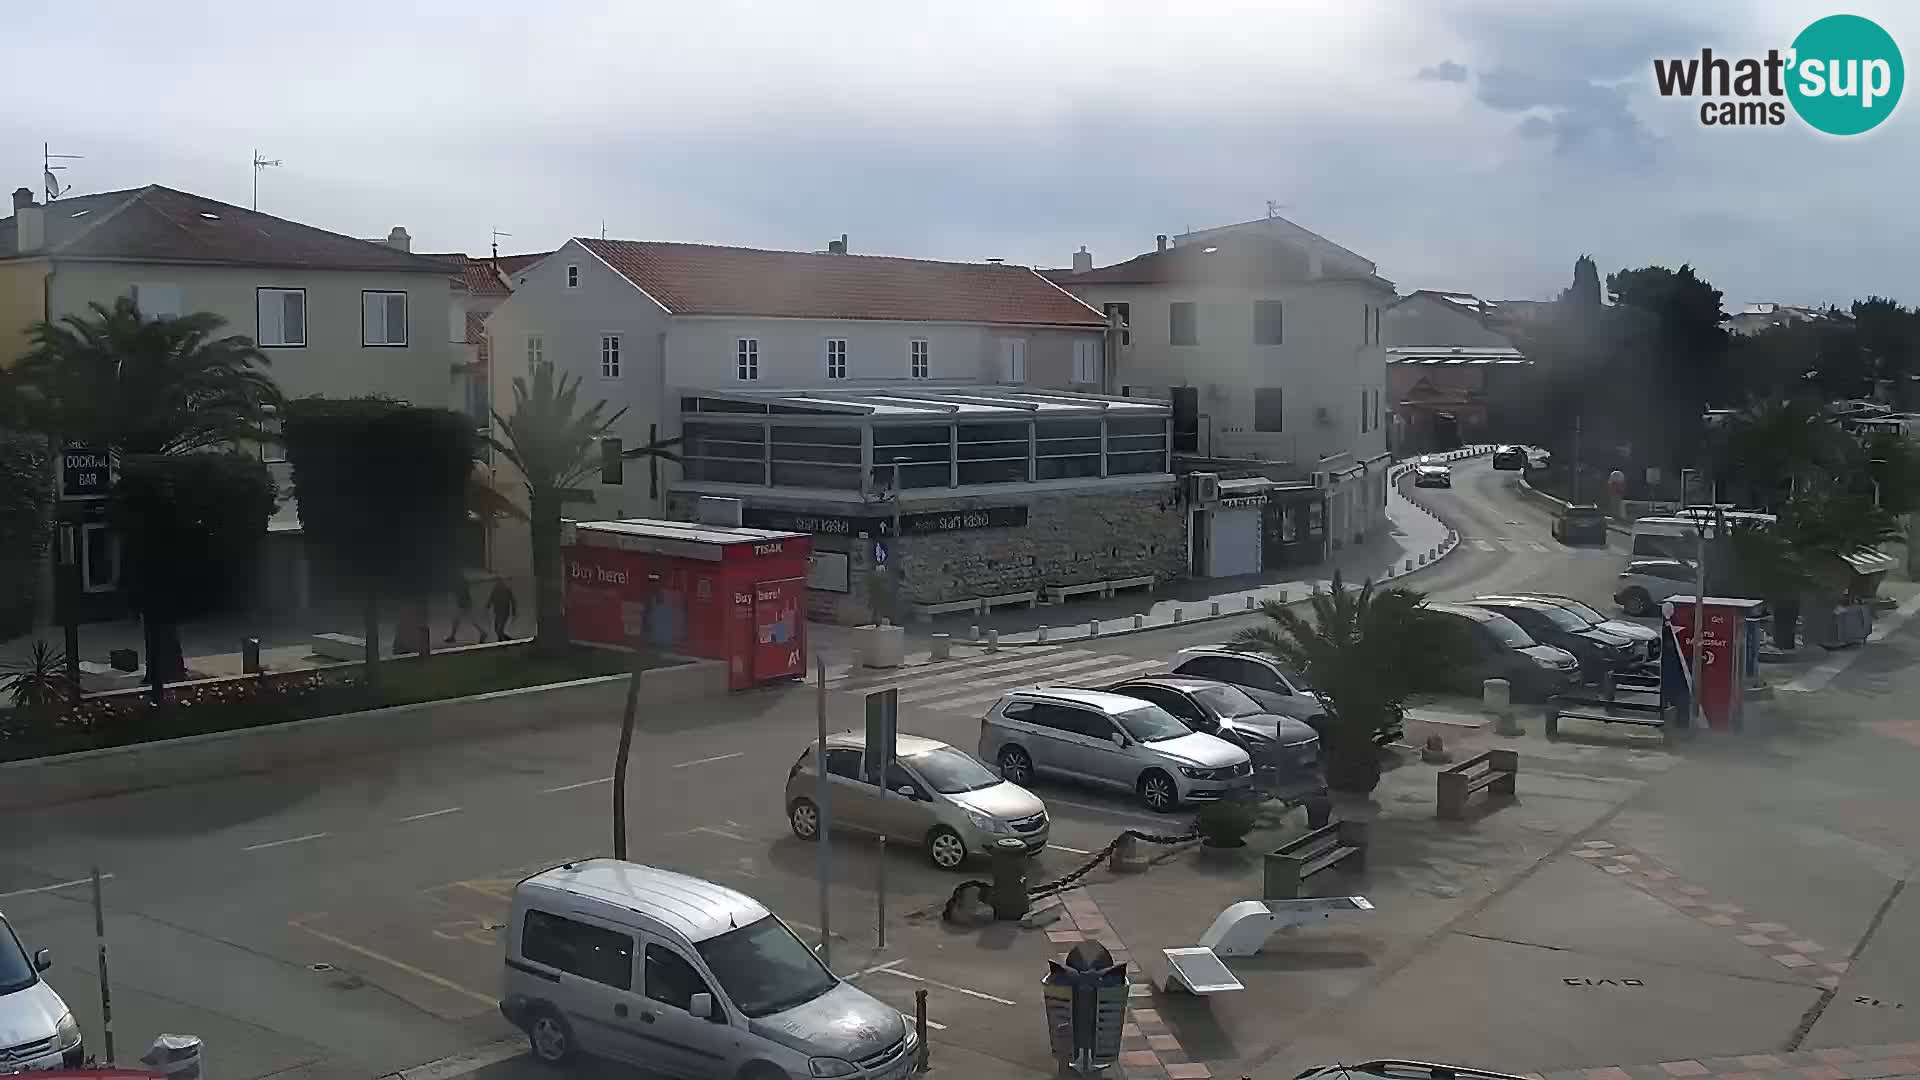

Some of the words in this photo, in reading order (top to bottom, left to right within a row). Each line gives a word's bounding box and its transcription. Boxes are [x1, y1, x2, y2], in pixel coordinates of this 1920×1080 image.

[79, 473, 97, 486] BAR
[754, 543, 783, 555] TISAK
[571, 561, 593, 584] Buy
[597, 566, 630, 585] here!
[735, 592, 753, 605] Buy
[787, 648, 800, 667] A1
